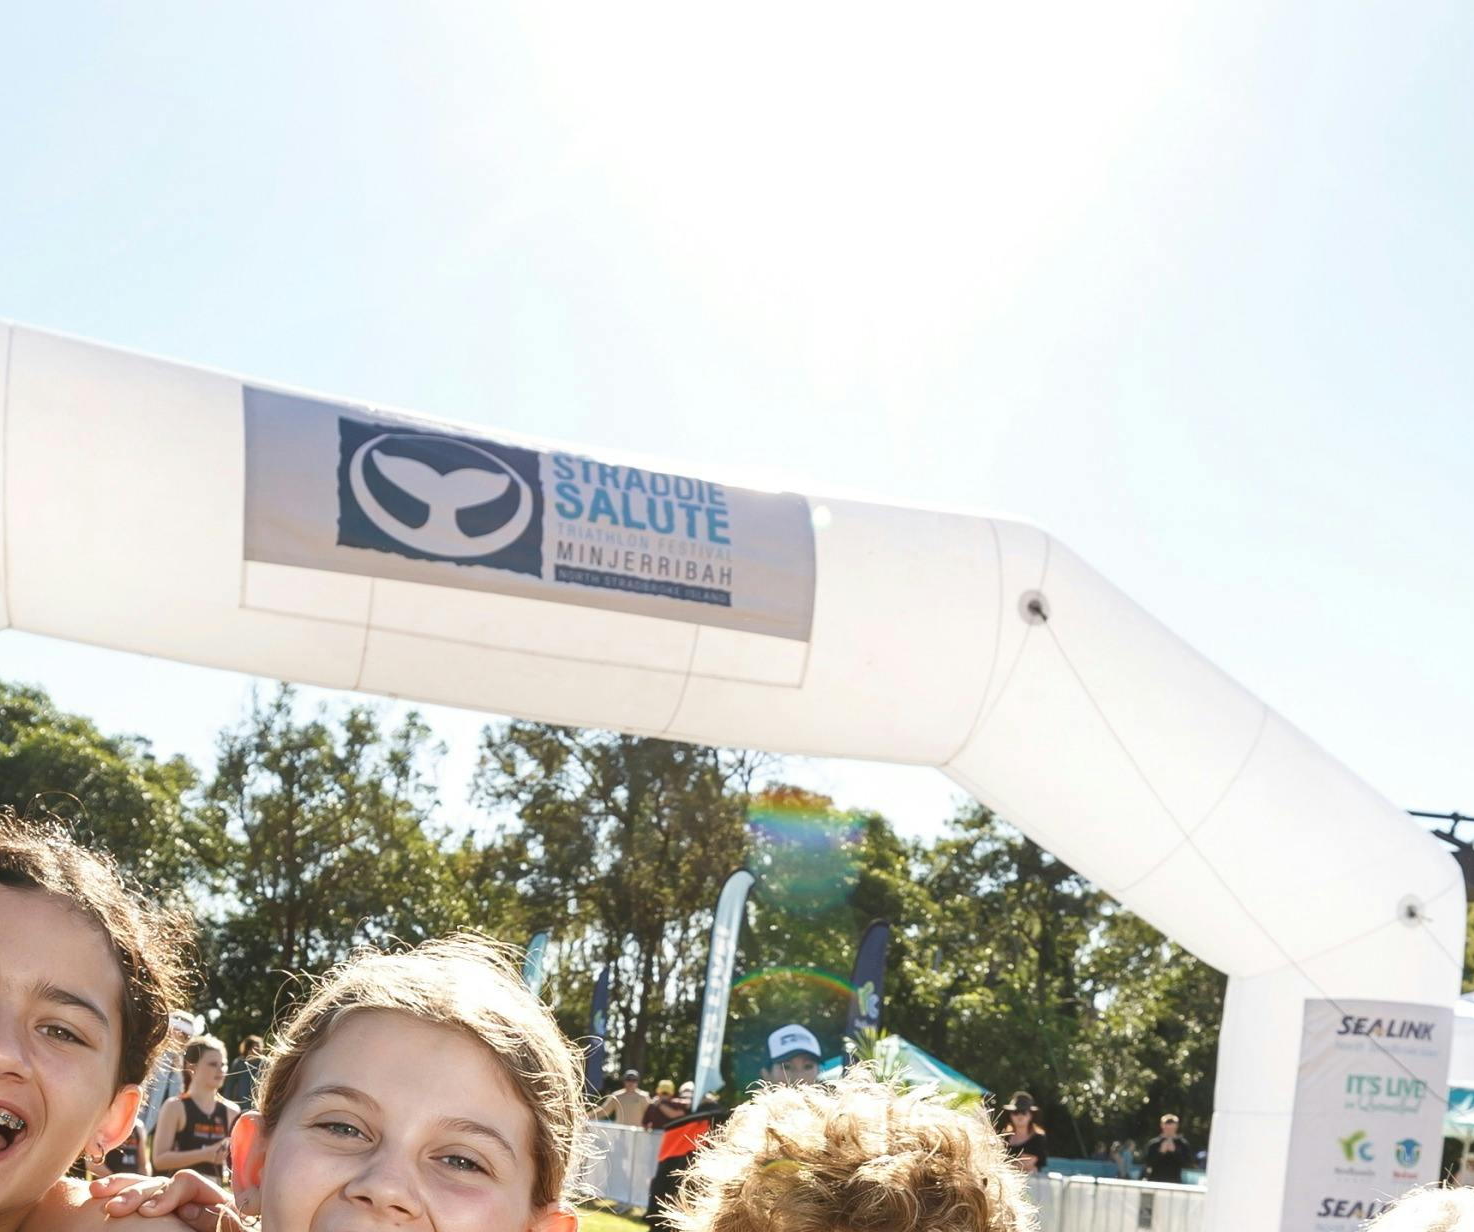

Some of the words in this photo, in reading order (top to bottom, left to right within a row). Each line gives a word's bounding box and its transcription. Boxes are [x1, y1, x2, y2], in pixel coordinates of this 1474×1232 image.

[553, 455, 727, 506] STRADDIE
[554, 481, 731, 544] SALUTE
[557, 522, 649, 550] TRIATHLON
[657, 537, 732, 562] FESTIVAL
[557, 540, 732, 586] MINJERRIBAH
[1337, 1015, 1435, 1041] SEALINK
[1387, 1077, 1427, 1099] LIVE
